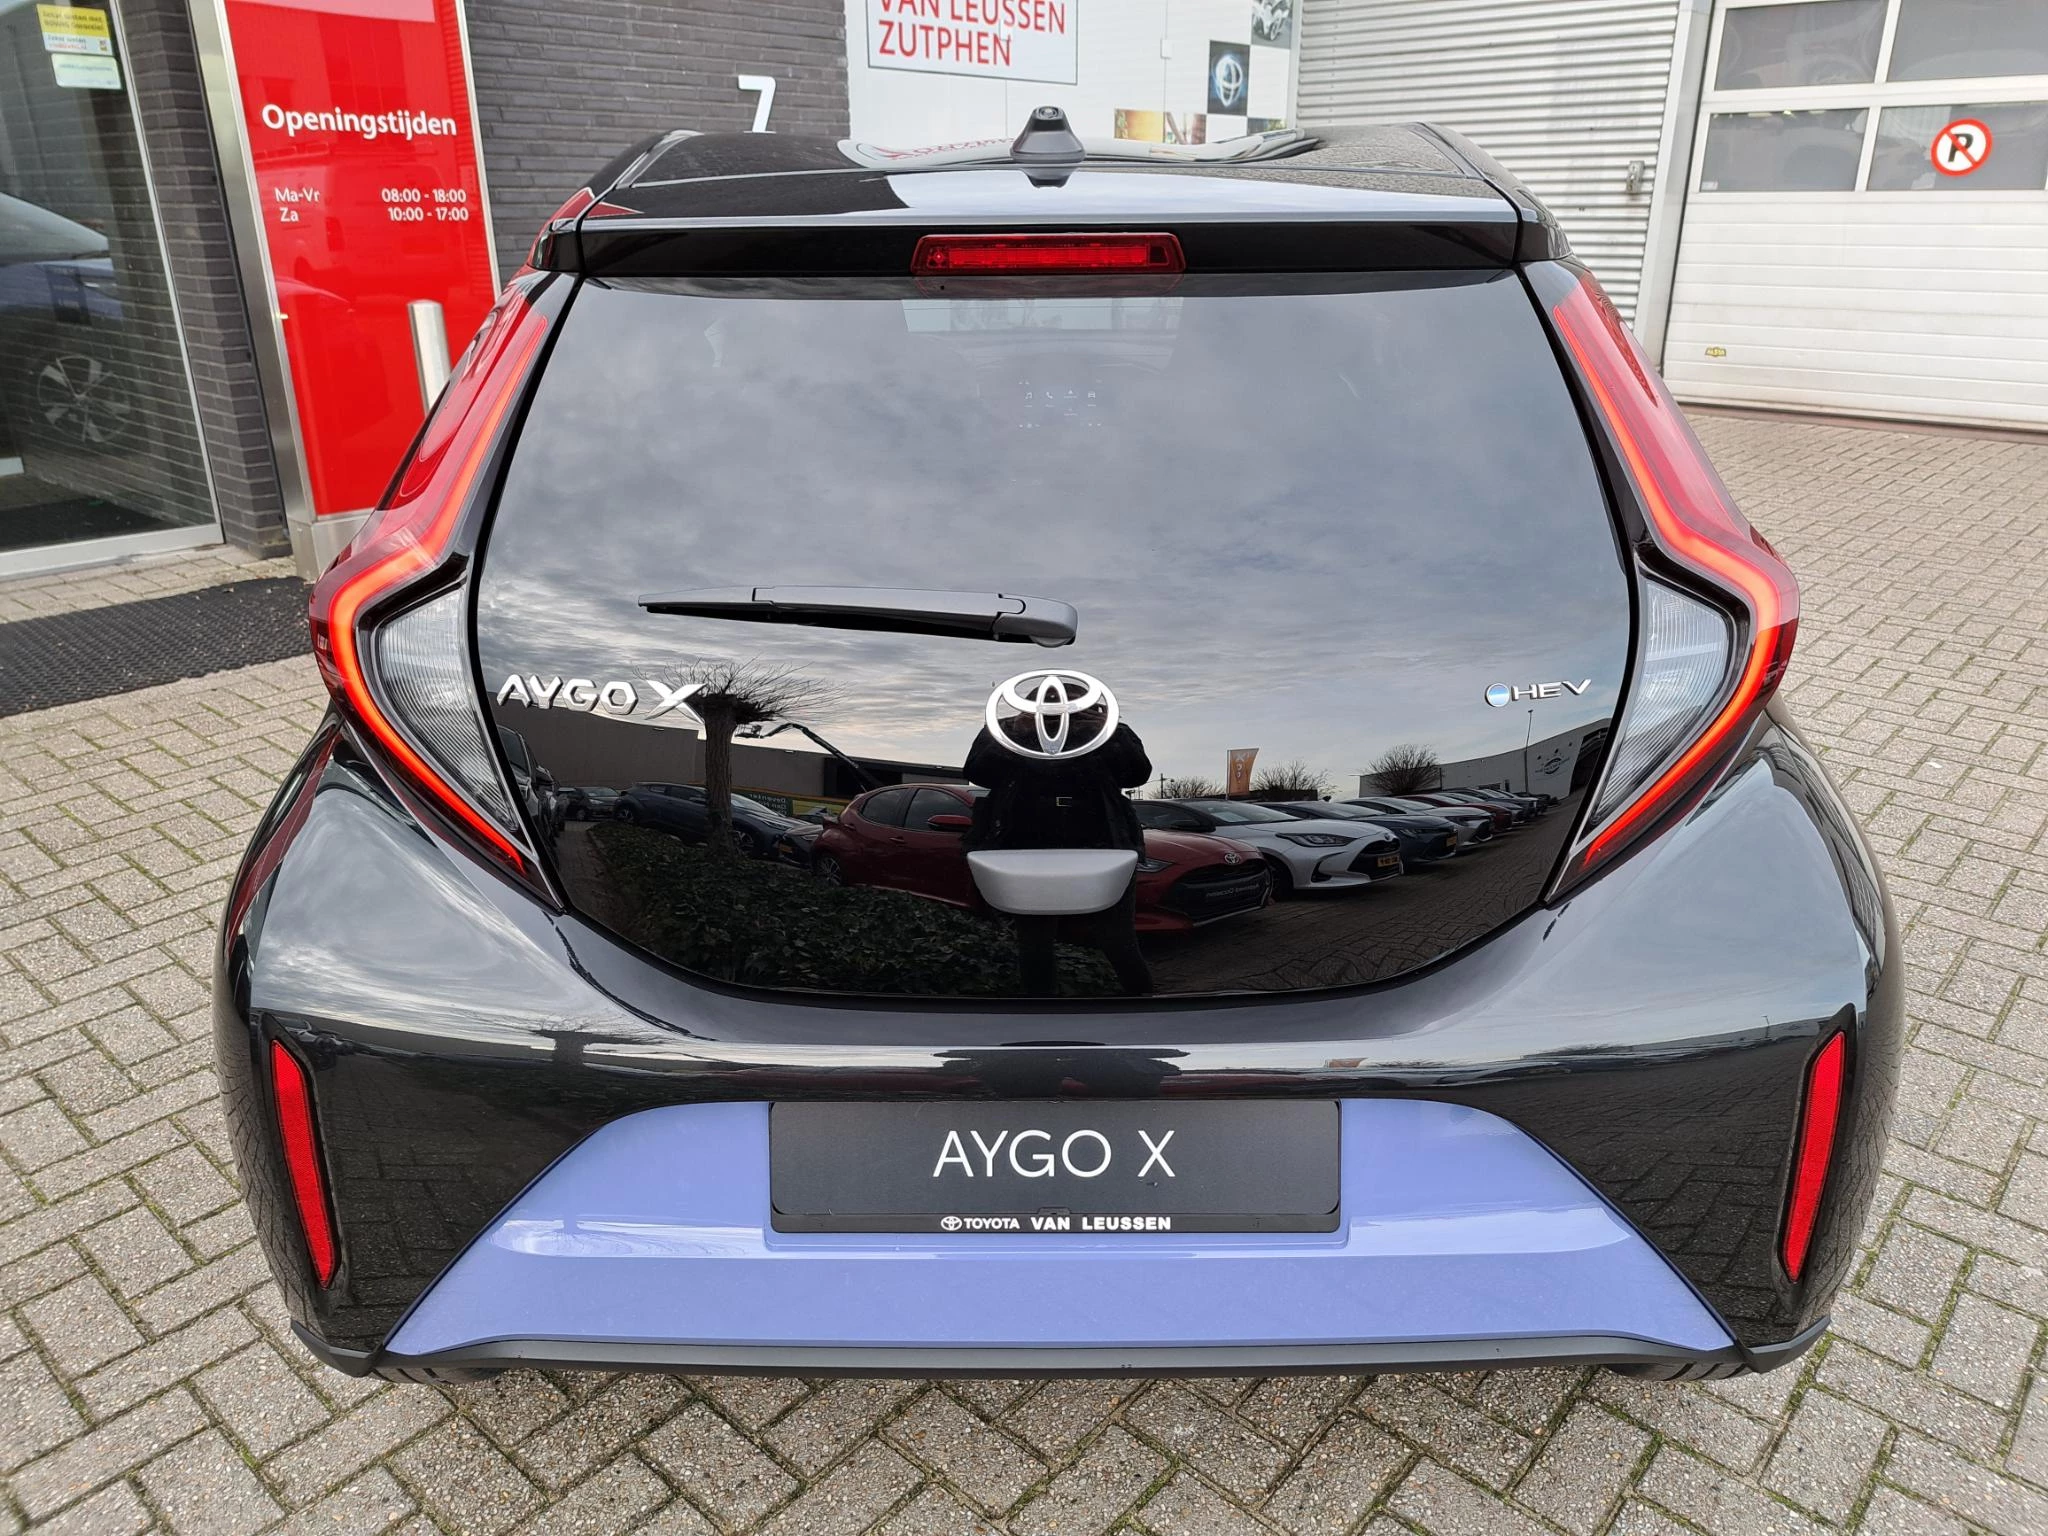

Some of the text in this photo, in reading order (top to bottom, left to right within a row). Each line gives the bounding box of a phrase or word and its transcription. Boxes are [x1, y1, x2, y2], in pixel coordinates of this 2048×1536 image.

[951, 0, 1065, 34] LEUSSEN
[879, 20, 1011, 66] ZUTPHEN
[738, 74, 776, 133] 7
[262, 104, 457, 141] Openingstijden
[274, 187, 320, 203] Ma-Vr
[381, 188, 421, 203] 08:00
[433, 188, 466, 203] 18:00
[280, 207, 299, 222] Za
[388, 206, 423, 221] 10:00
[435, 207, 469, 221] 17:00
[497, 674, 707, 725] AYGO X
[1511, 679, 1592, 701] HEV
[932, 1129, 1176, 1178] AYGO X
[964, 1216, 1171, 1230] TOYOTA VAN LEUSSEN
